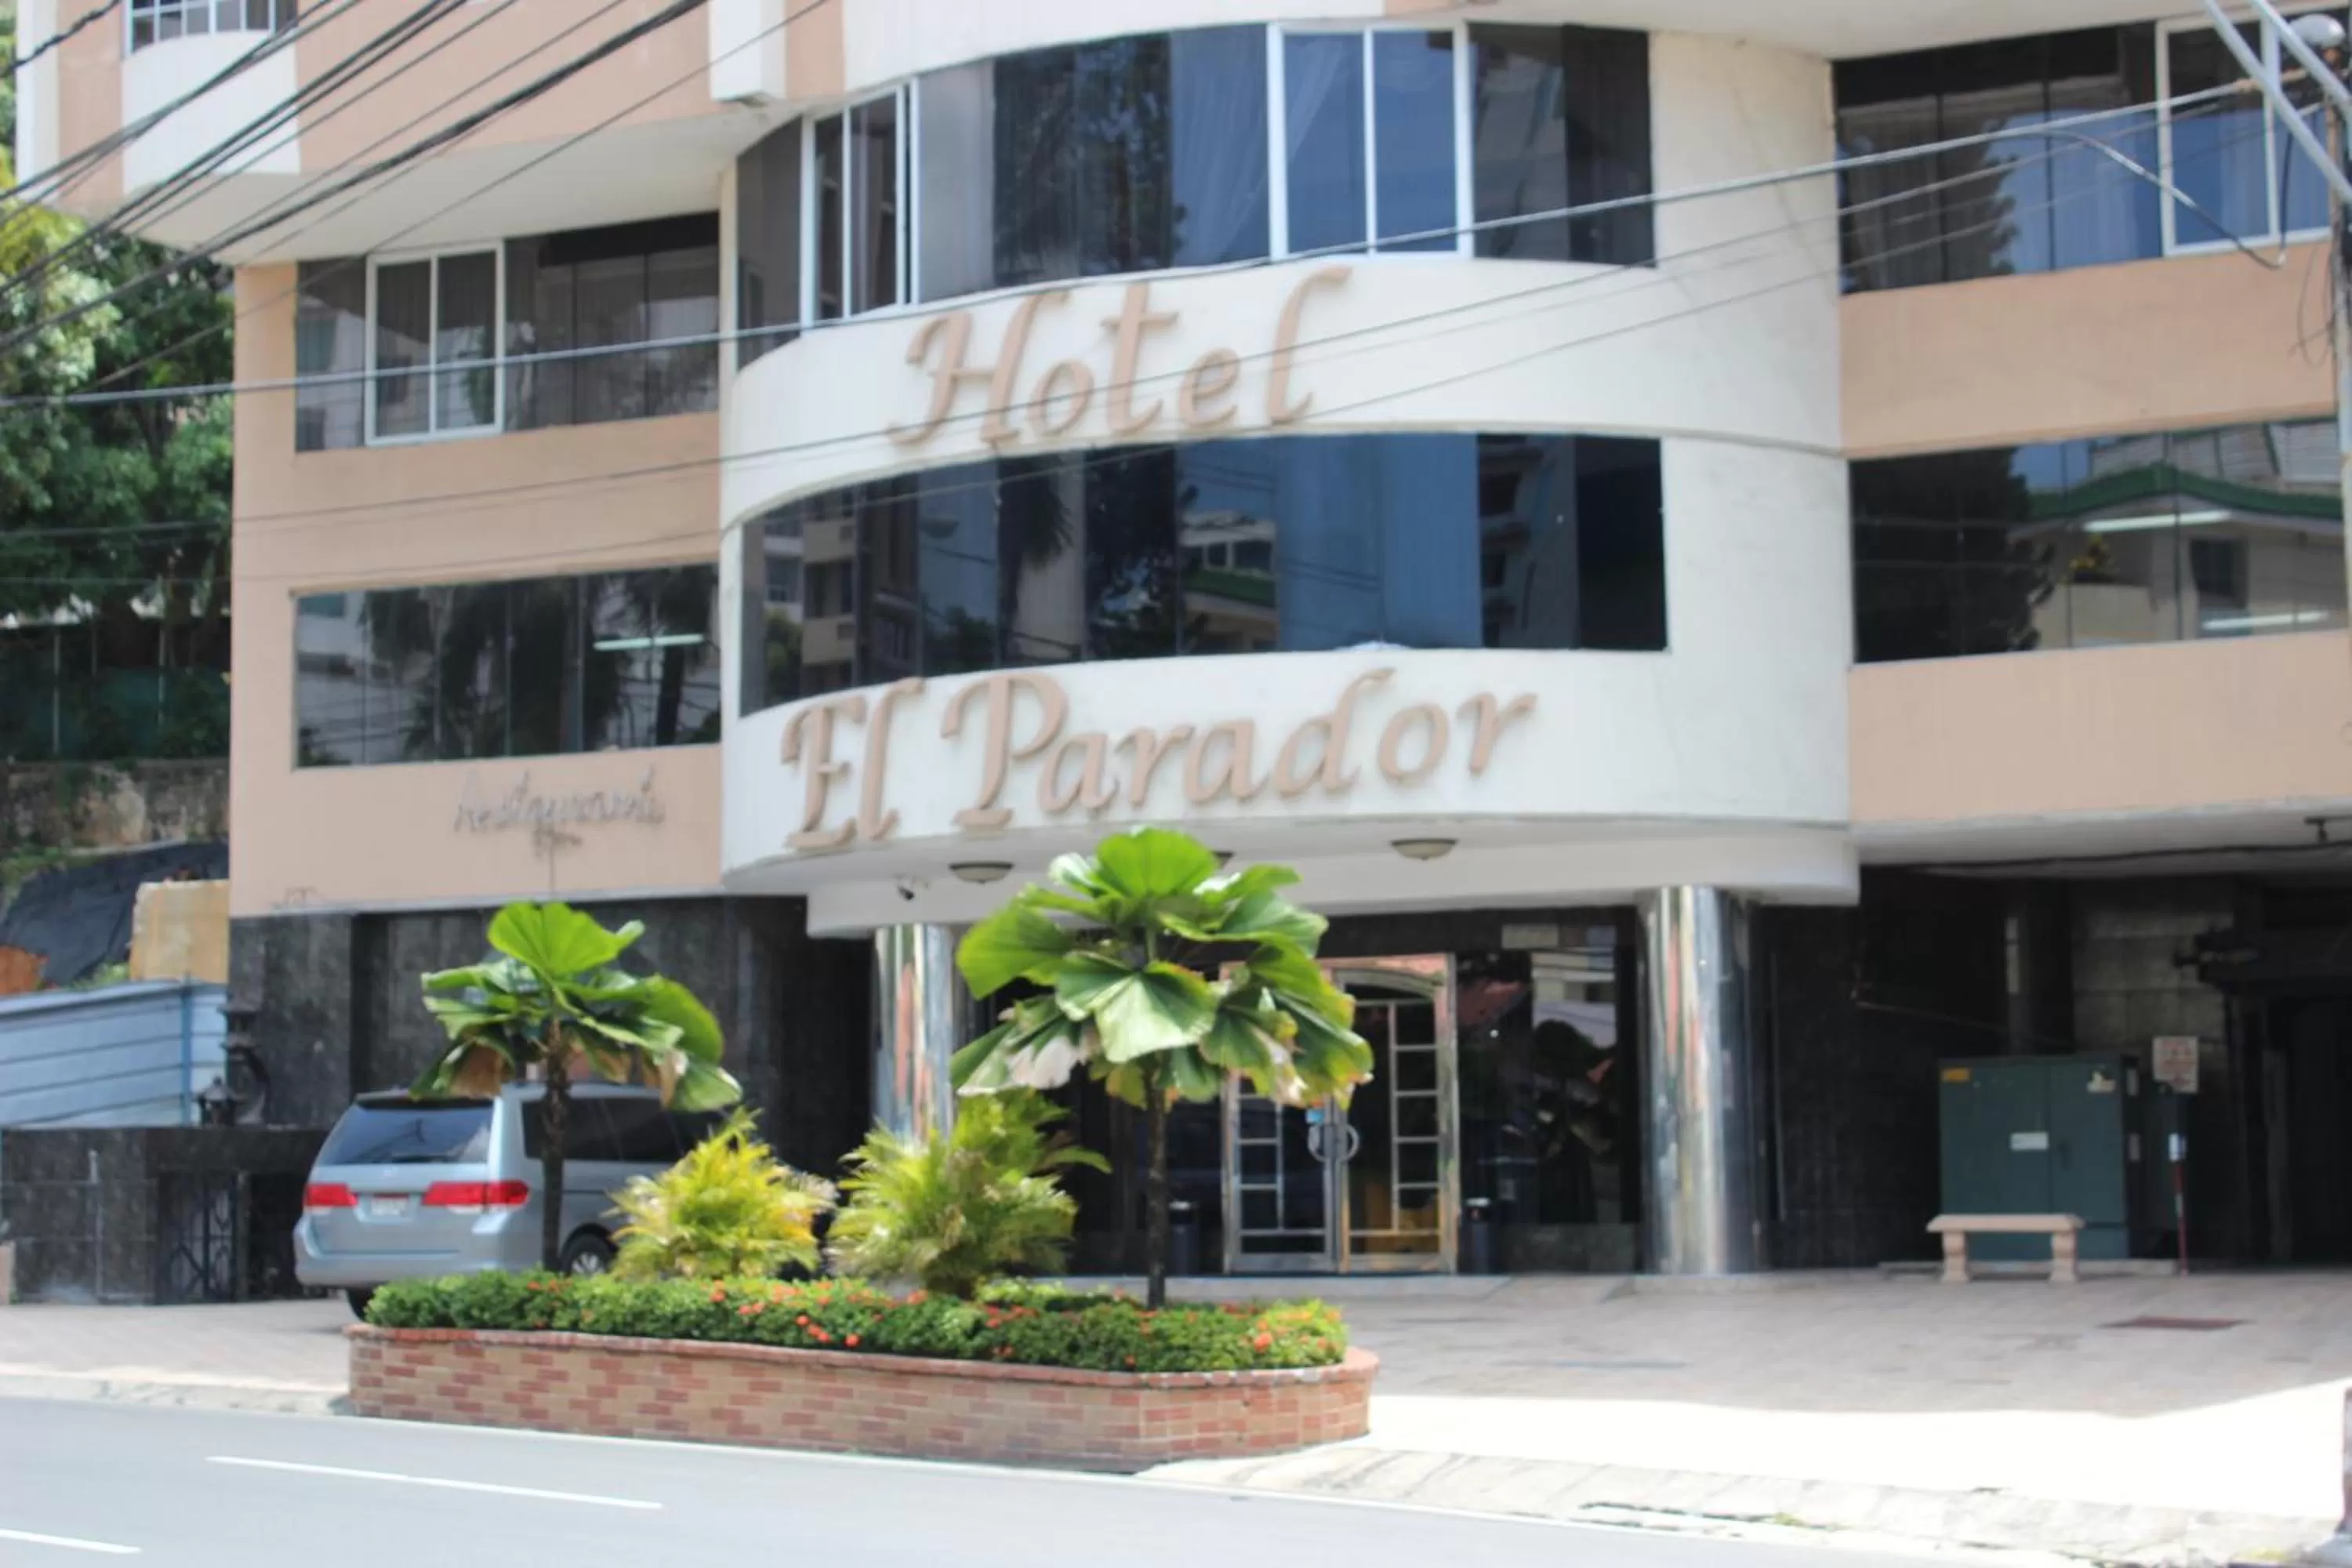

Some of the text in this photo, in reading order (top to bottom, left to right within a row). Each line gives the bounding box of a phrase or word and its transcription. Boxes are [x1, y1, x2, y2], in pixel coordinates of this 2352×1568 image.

[887, 266, 1352, 449] Hotel
[782, 668, 1538, 850] El Parador
